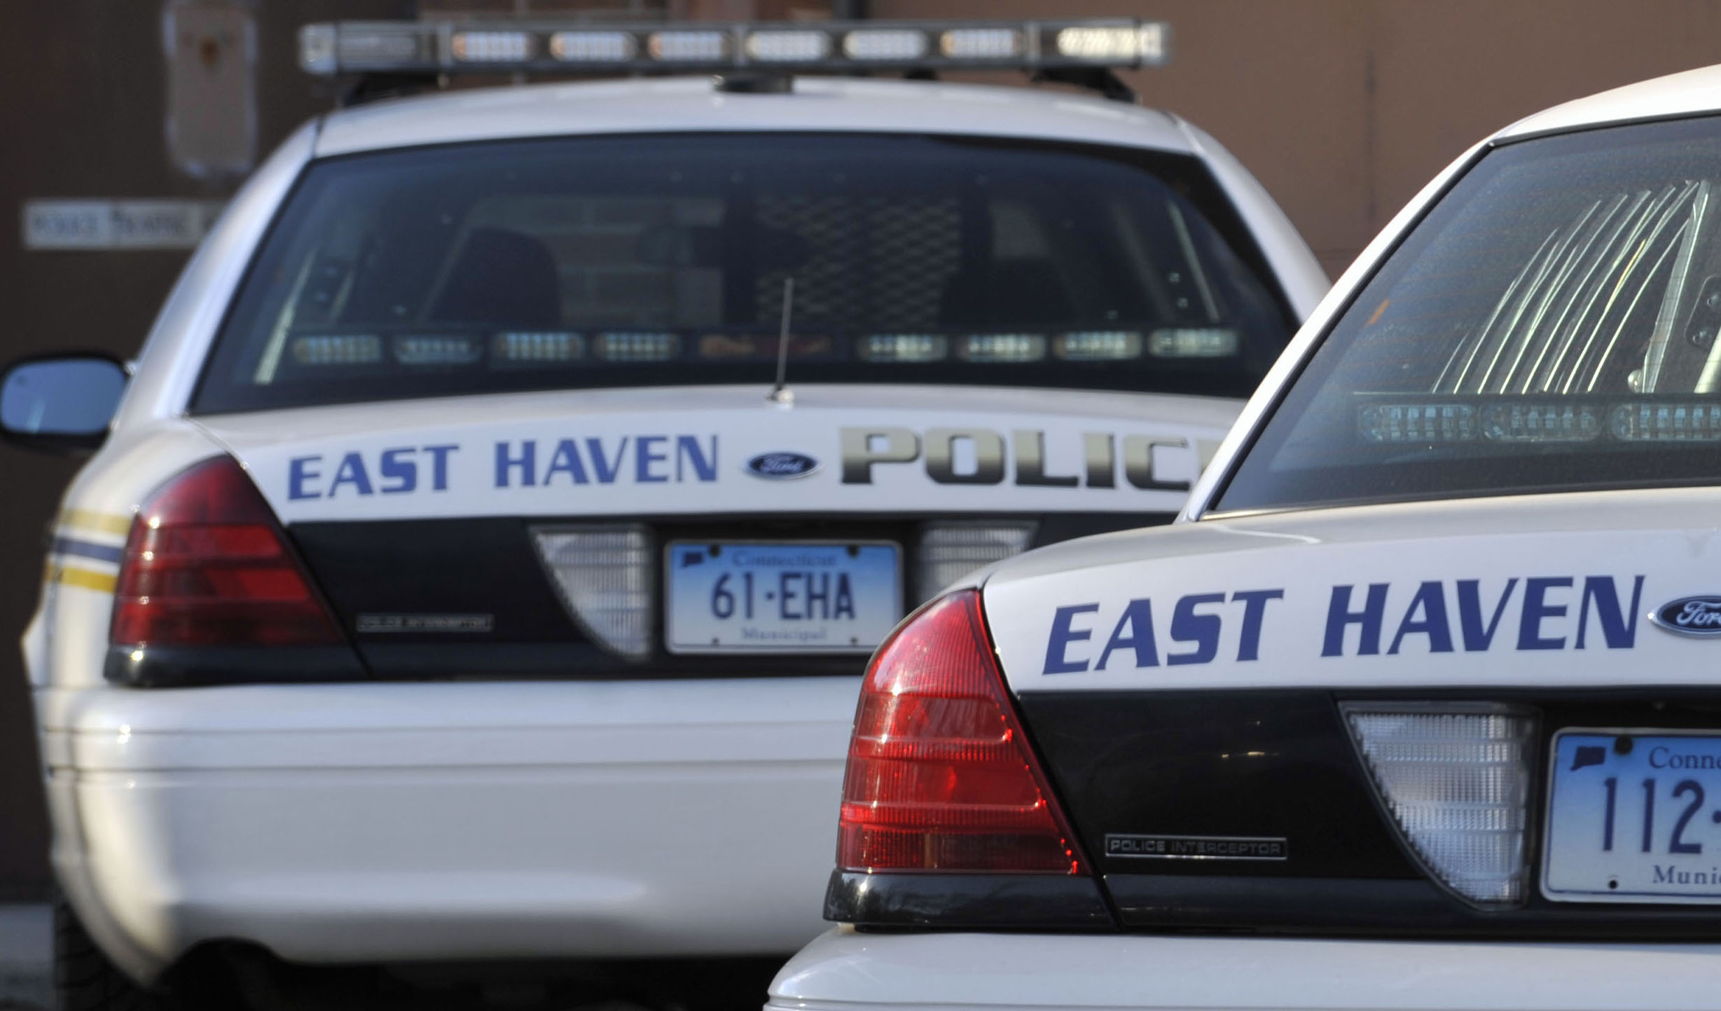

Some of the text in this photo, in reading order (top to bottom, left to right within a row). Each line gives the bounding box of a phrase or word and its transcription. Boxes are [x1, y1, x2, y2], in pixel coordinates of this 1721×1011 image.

[288, 426, 1222, 500] EAST HAVEN POLIC
[1042, 574, 1646, 675] EAST HAVEN
[1676, 600, 1721, 626] For
[1110, 839, 1282, 855] POLICE INTERCEPTOR
[1652, 864, 1721, 885] Muni
